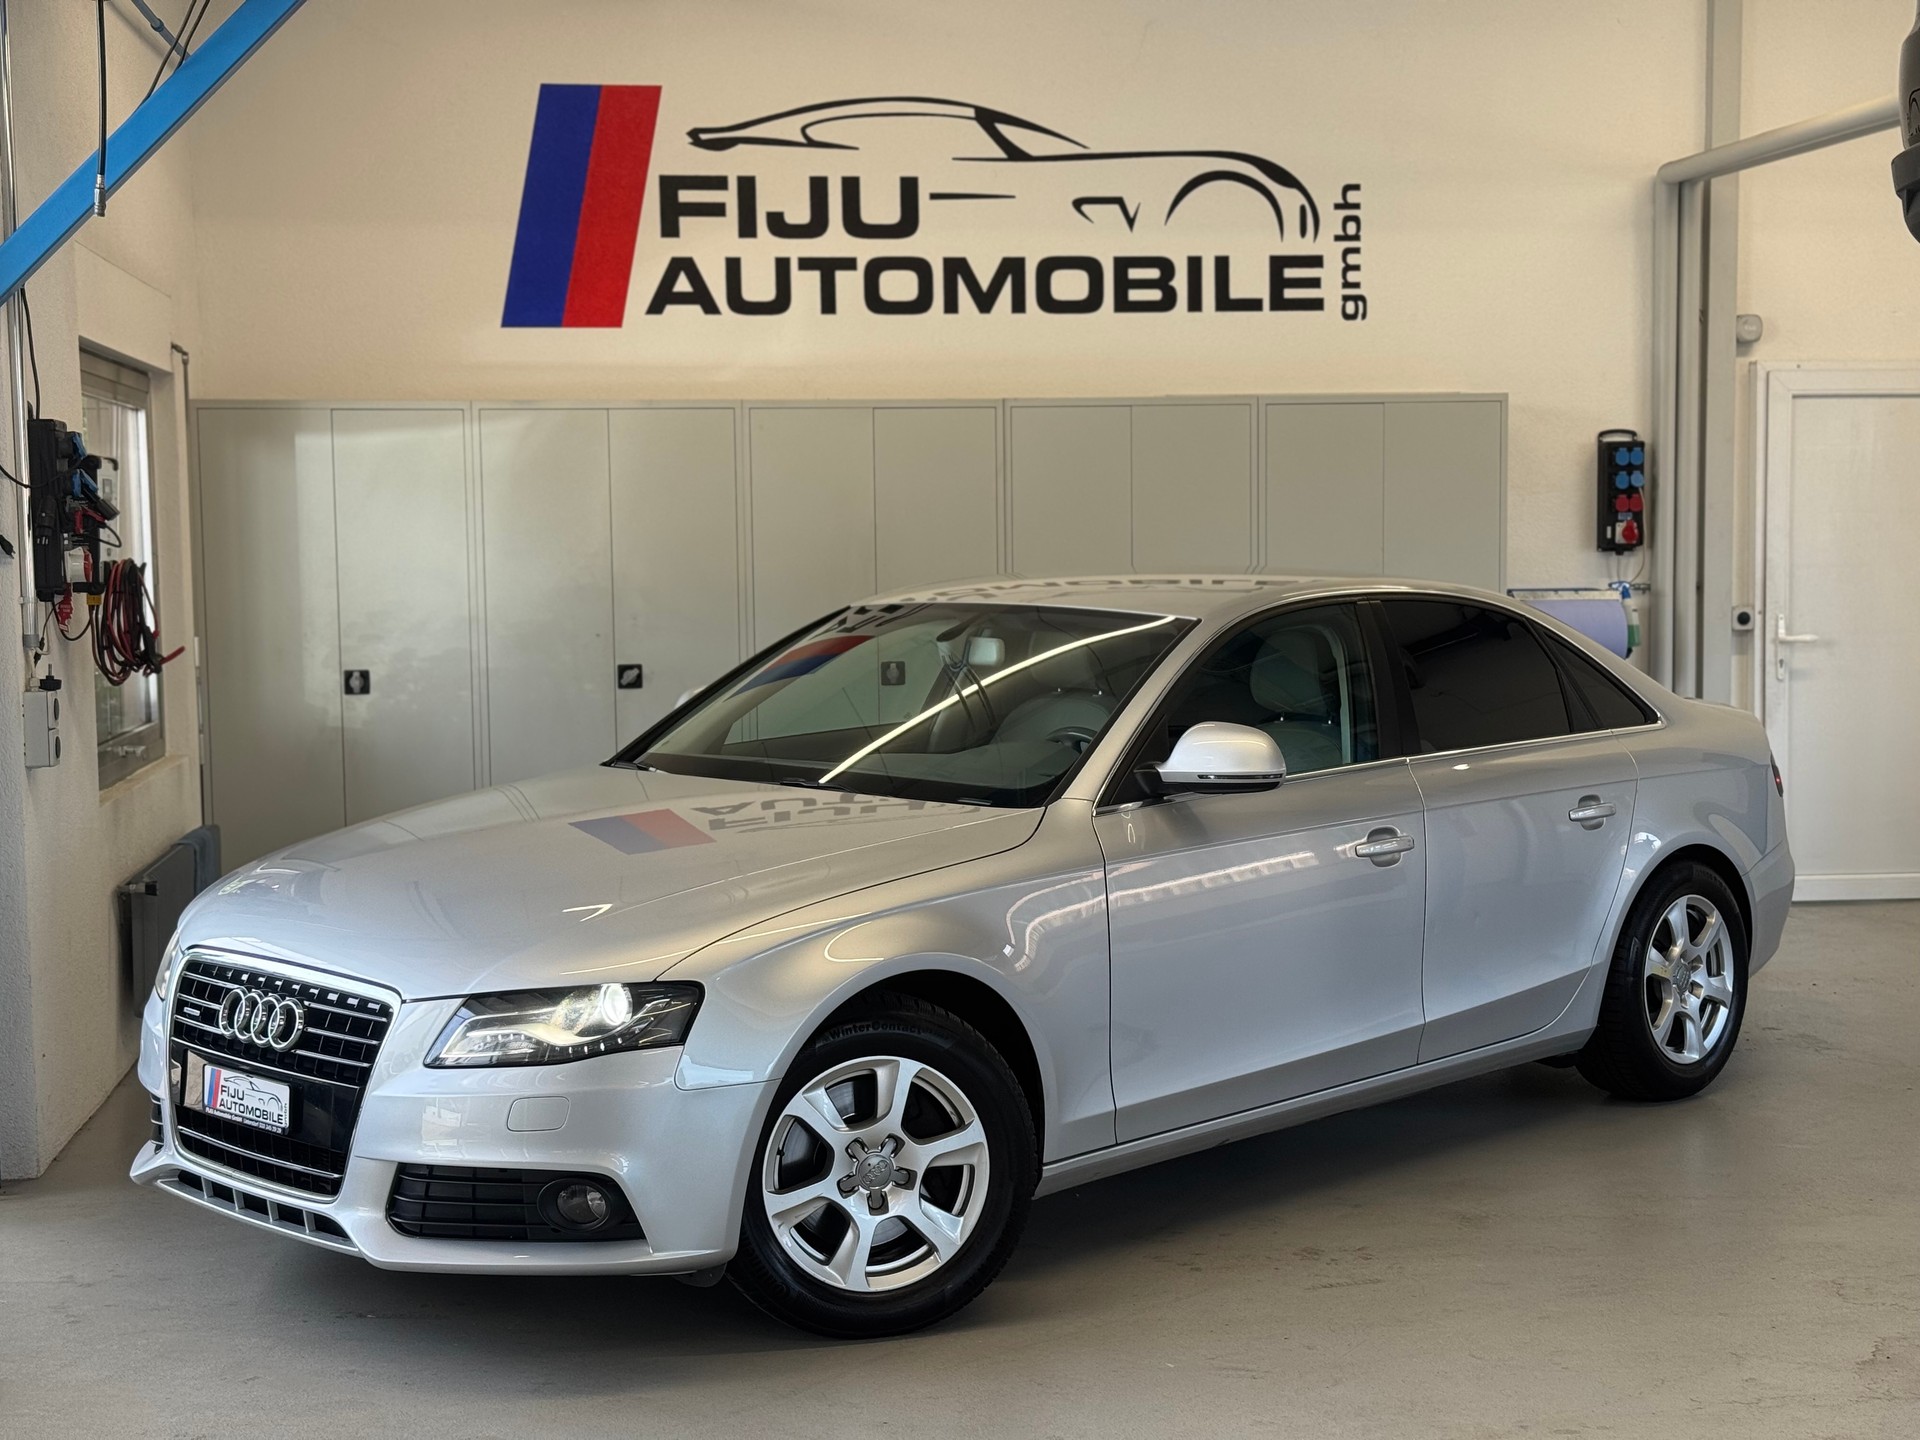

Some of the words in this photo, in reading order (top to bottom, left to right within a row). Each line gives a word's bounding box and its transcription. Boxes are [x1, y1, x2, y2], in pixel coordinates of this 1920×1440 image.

[659, 174, 920, 240] FIJU
[1332, 183, 1367, 322] gmbh
[645, 255, 1325, 316] AUTOMOBILE
[219, 1098, 284, 1125] AUTOMOBILE
[220, 1084, 245, 1101] FIJU
